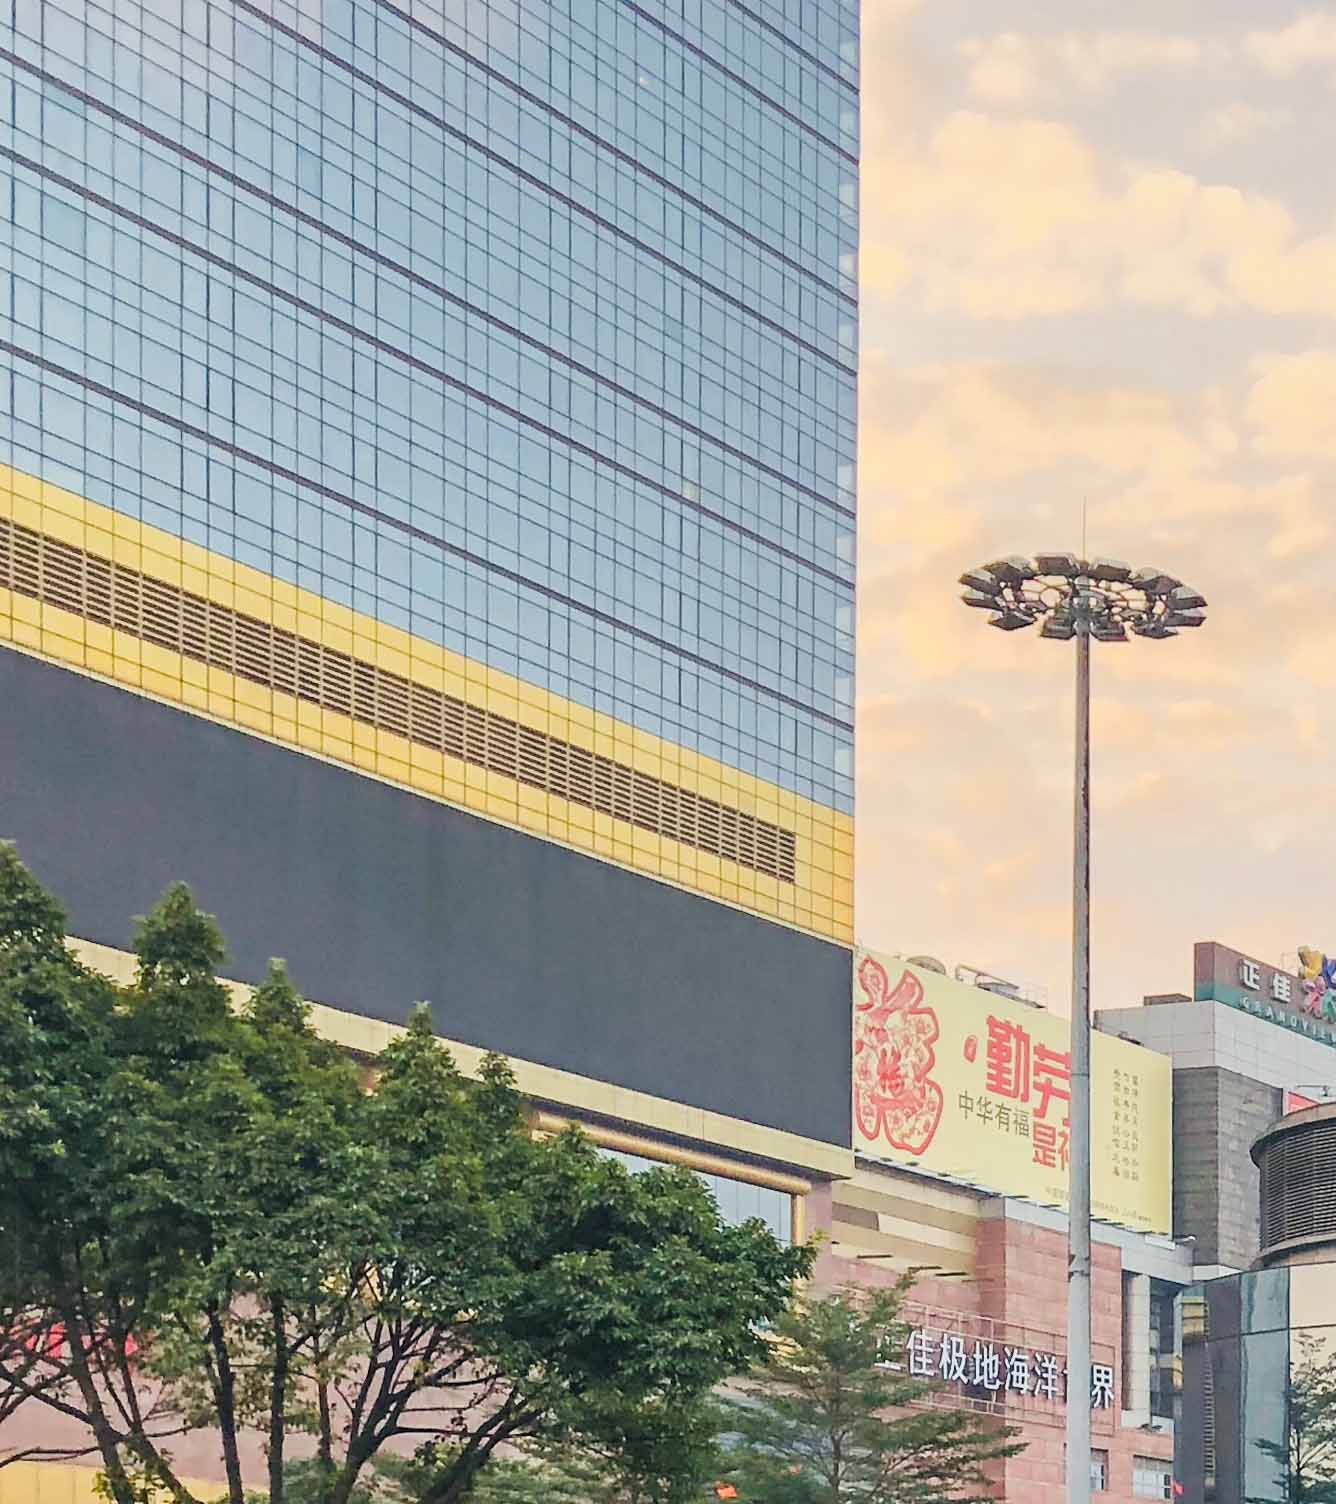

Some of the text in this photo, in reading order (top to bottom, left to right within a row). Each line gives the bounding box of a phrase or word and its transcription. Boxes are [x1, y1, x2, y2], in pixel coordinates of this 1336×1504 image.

[957, 1089, 1031, 1138] 中华有福
[874, 1327, 1115, 1410] 佳极地海洋界
